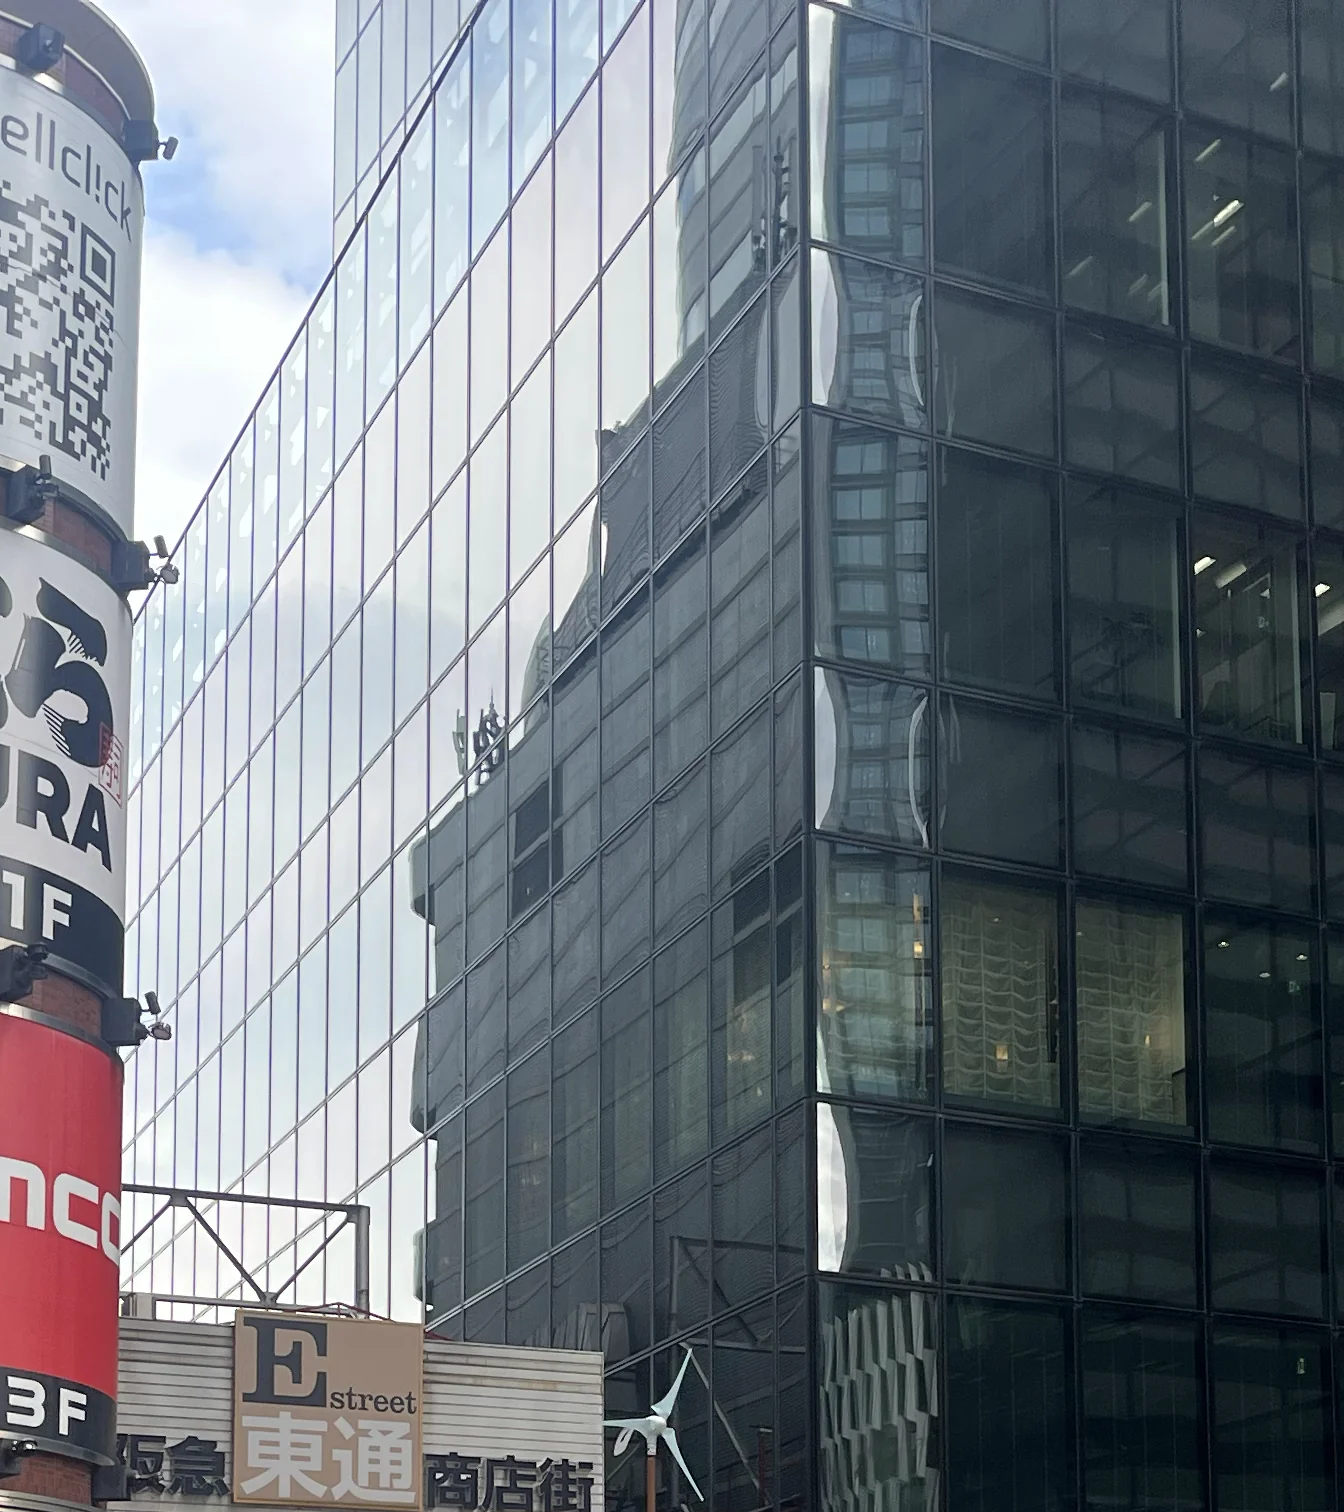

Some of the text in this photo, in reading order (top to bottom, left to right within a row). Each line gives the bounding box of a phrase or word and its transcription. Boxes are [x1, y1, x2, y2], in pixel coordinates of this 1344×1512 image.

[242, 1316, 418, 1416] E street
[117, 1434, 231, 1497] 阪急
[240, 1410, 418, 1505] 東通
